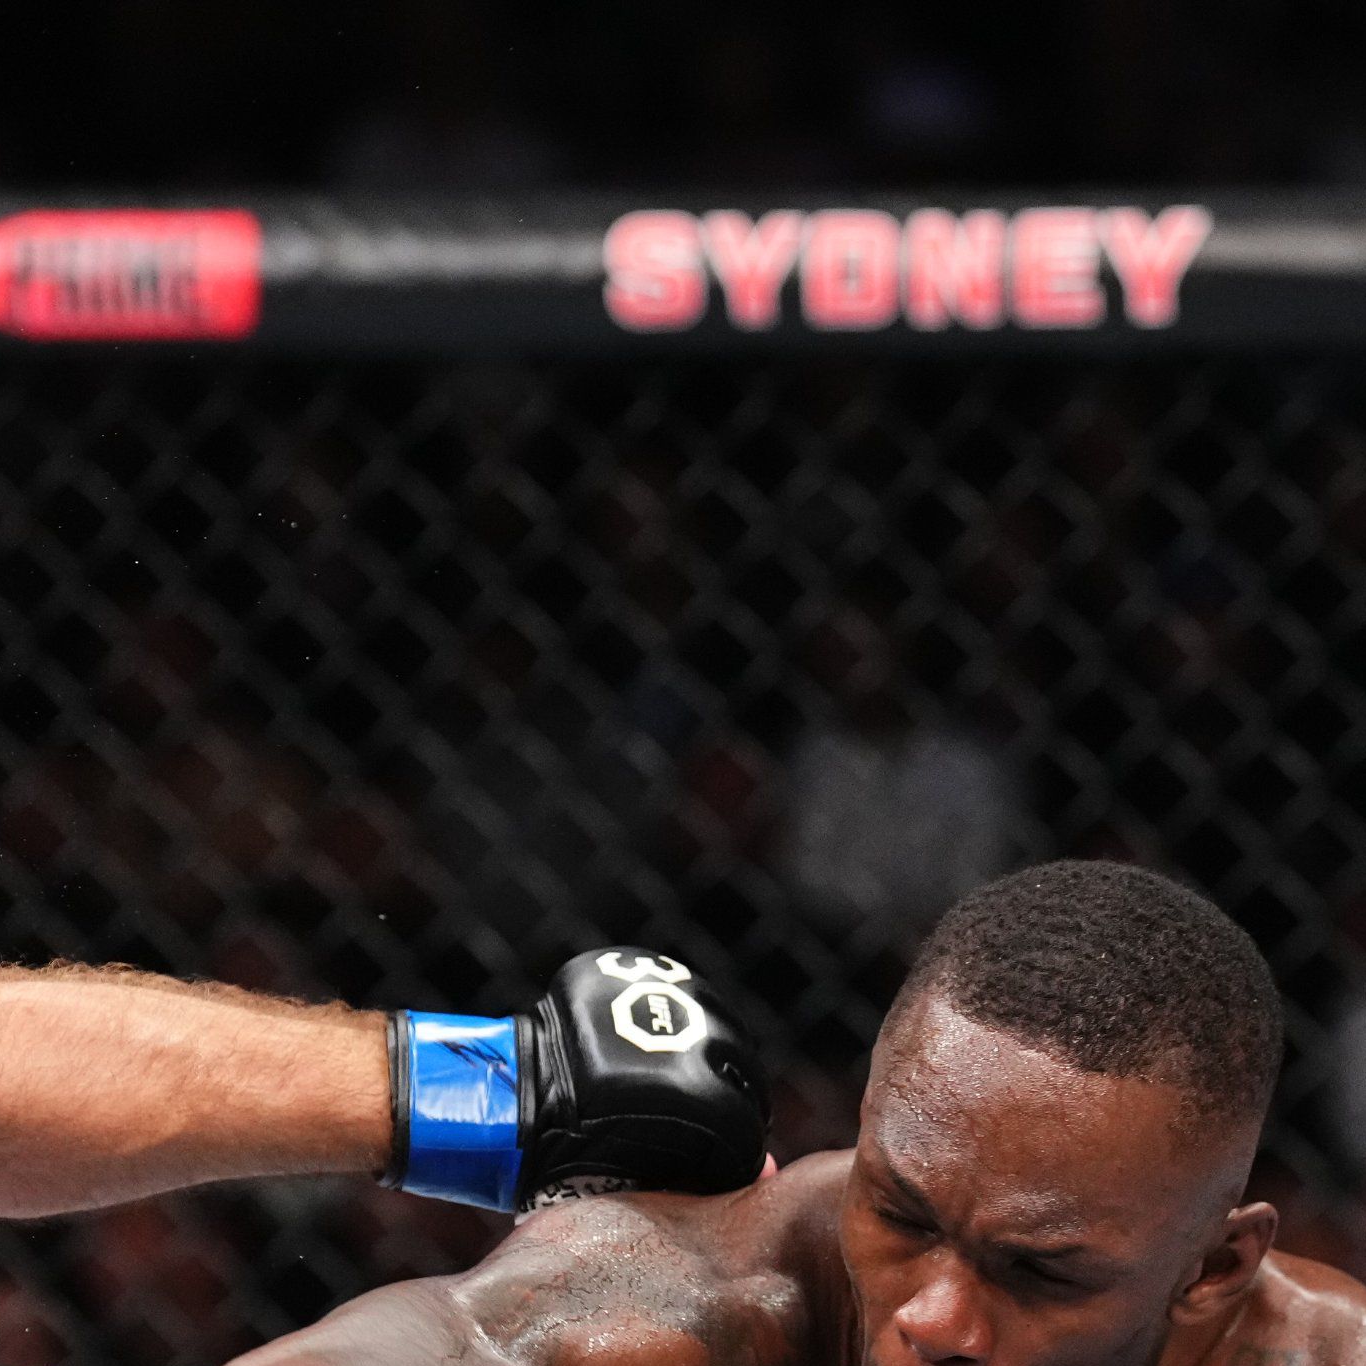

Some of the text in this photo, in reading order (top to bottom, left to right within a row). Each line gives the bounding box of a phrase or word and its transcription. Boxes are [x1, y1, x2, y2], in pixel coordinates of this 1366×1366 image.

[602, 205, 1213, 333] SYDNEY
[596, 952, 708, 1053] 30
[647, 994, 675, 1034] UFC
